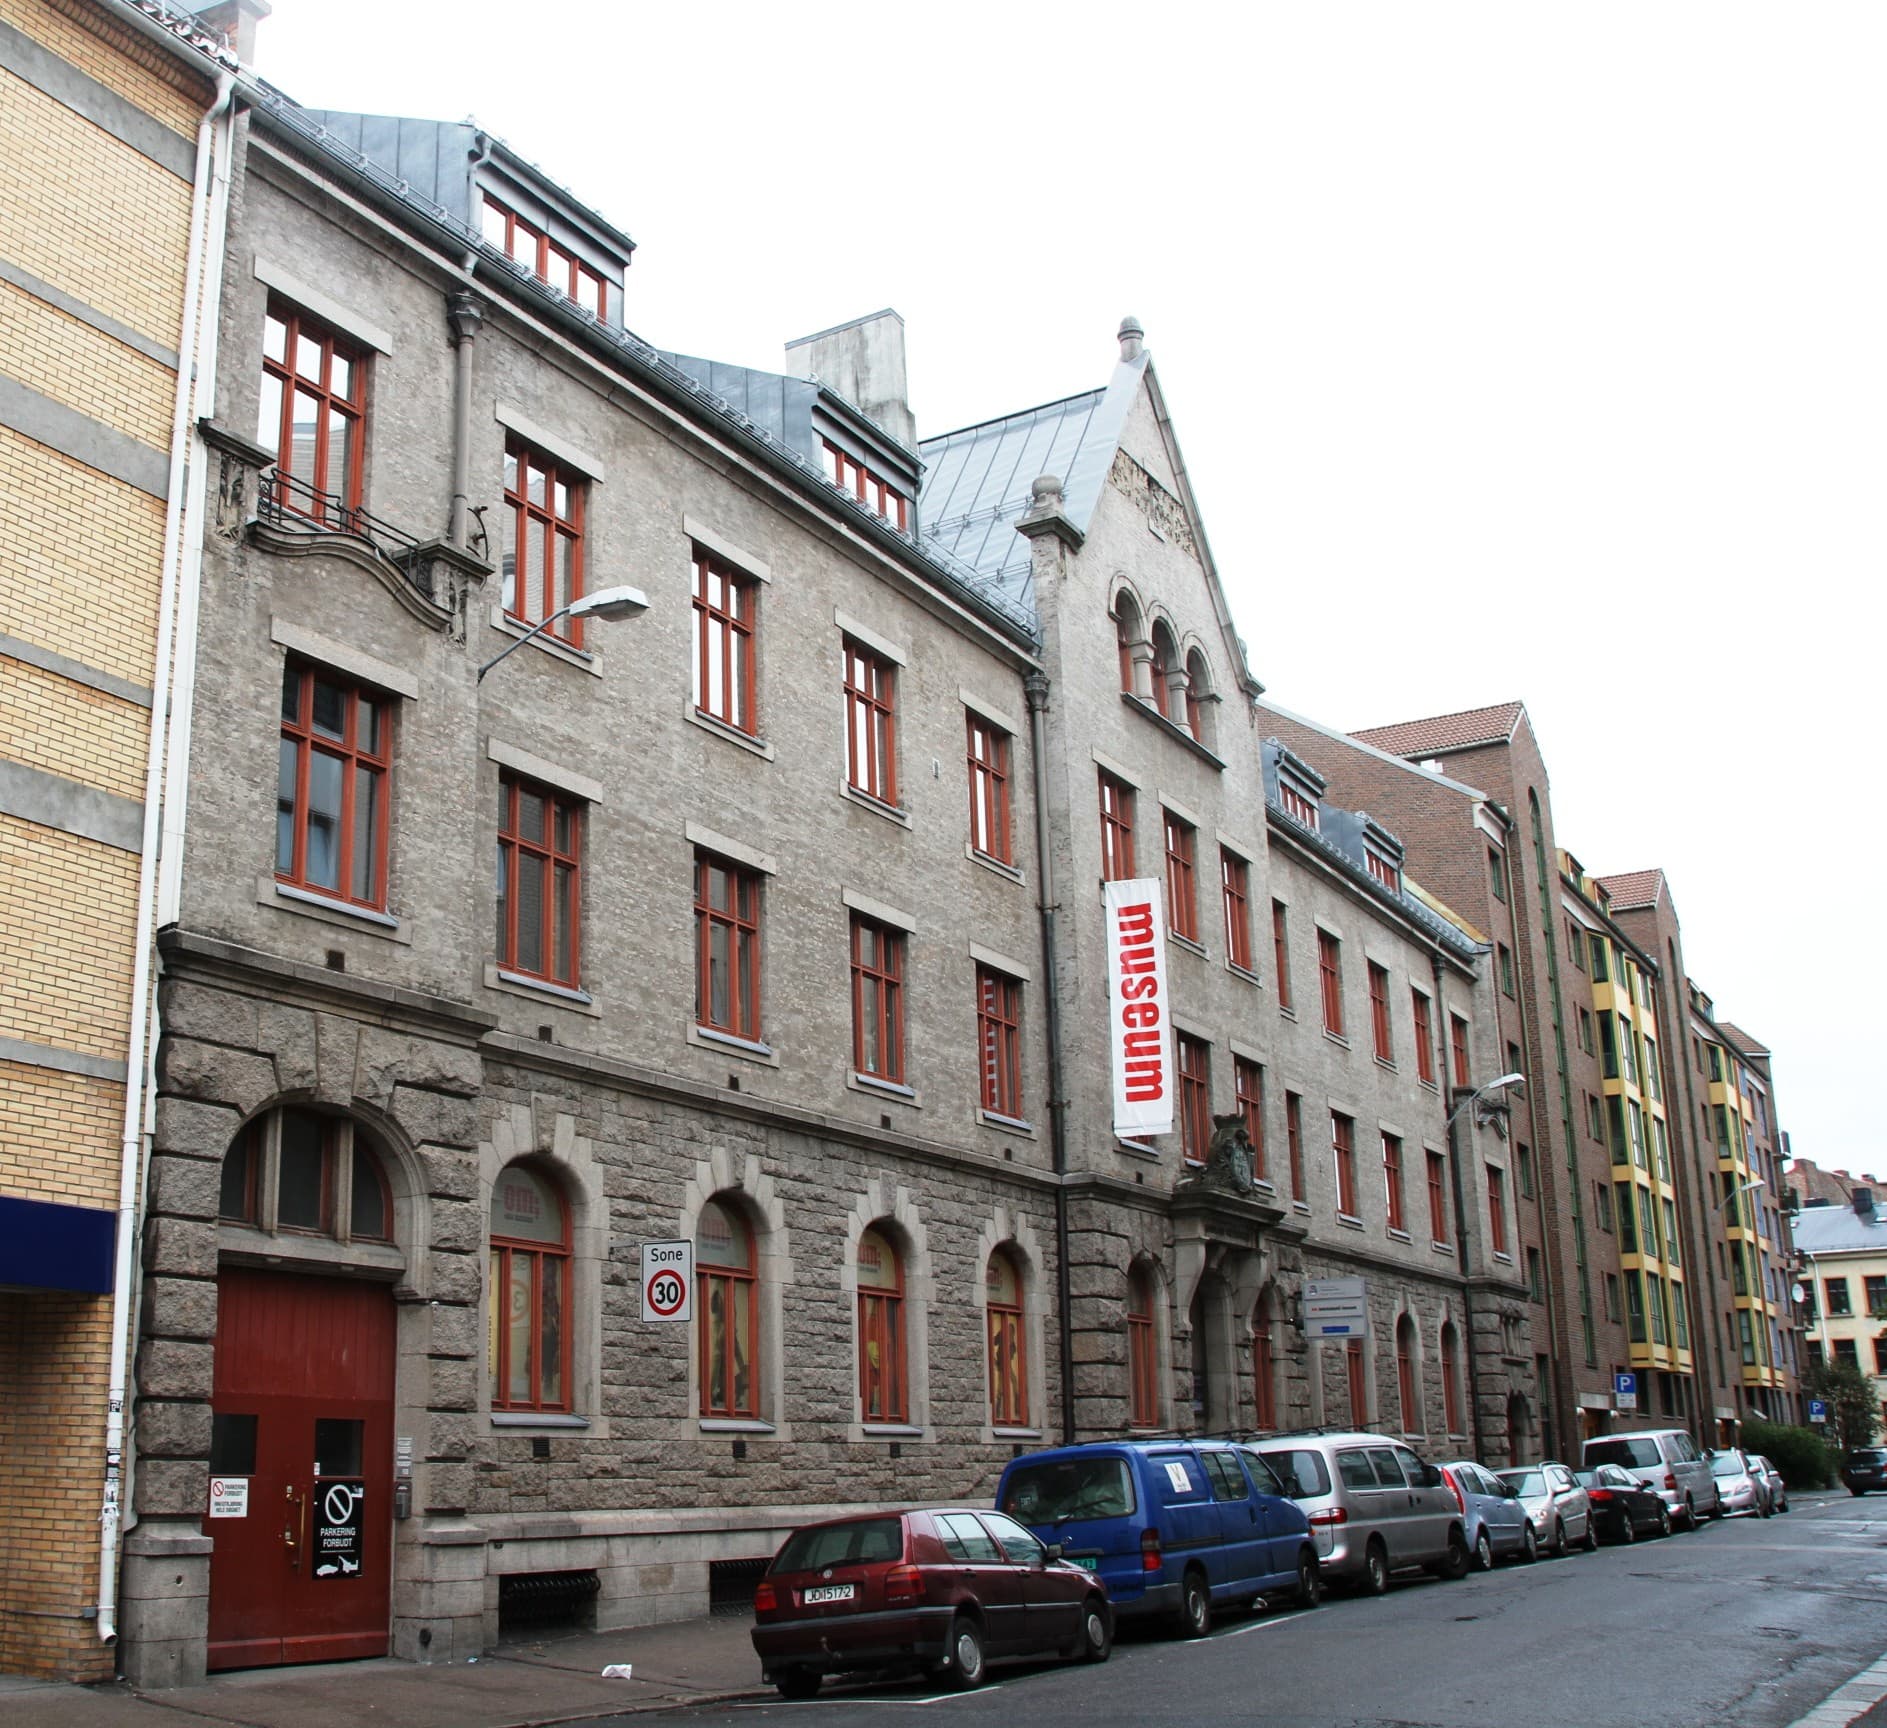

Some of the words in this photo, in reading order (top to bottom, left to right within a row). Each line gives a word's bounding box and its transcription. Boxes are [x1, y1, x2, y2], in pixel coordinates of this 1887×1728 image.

[1117, 902, 1164, 1102] museum
[651, 1248, 683, 1262] Sone
[655, 1281, 679, 1304] 30
[1620, 1376, 1631, 1391] P
[1812, 1402, 1822, 1413] P
[320, 1527, 356, 1537] PARKERING
[323, 1538, 353, 1548] FORBUDT
